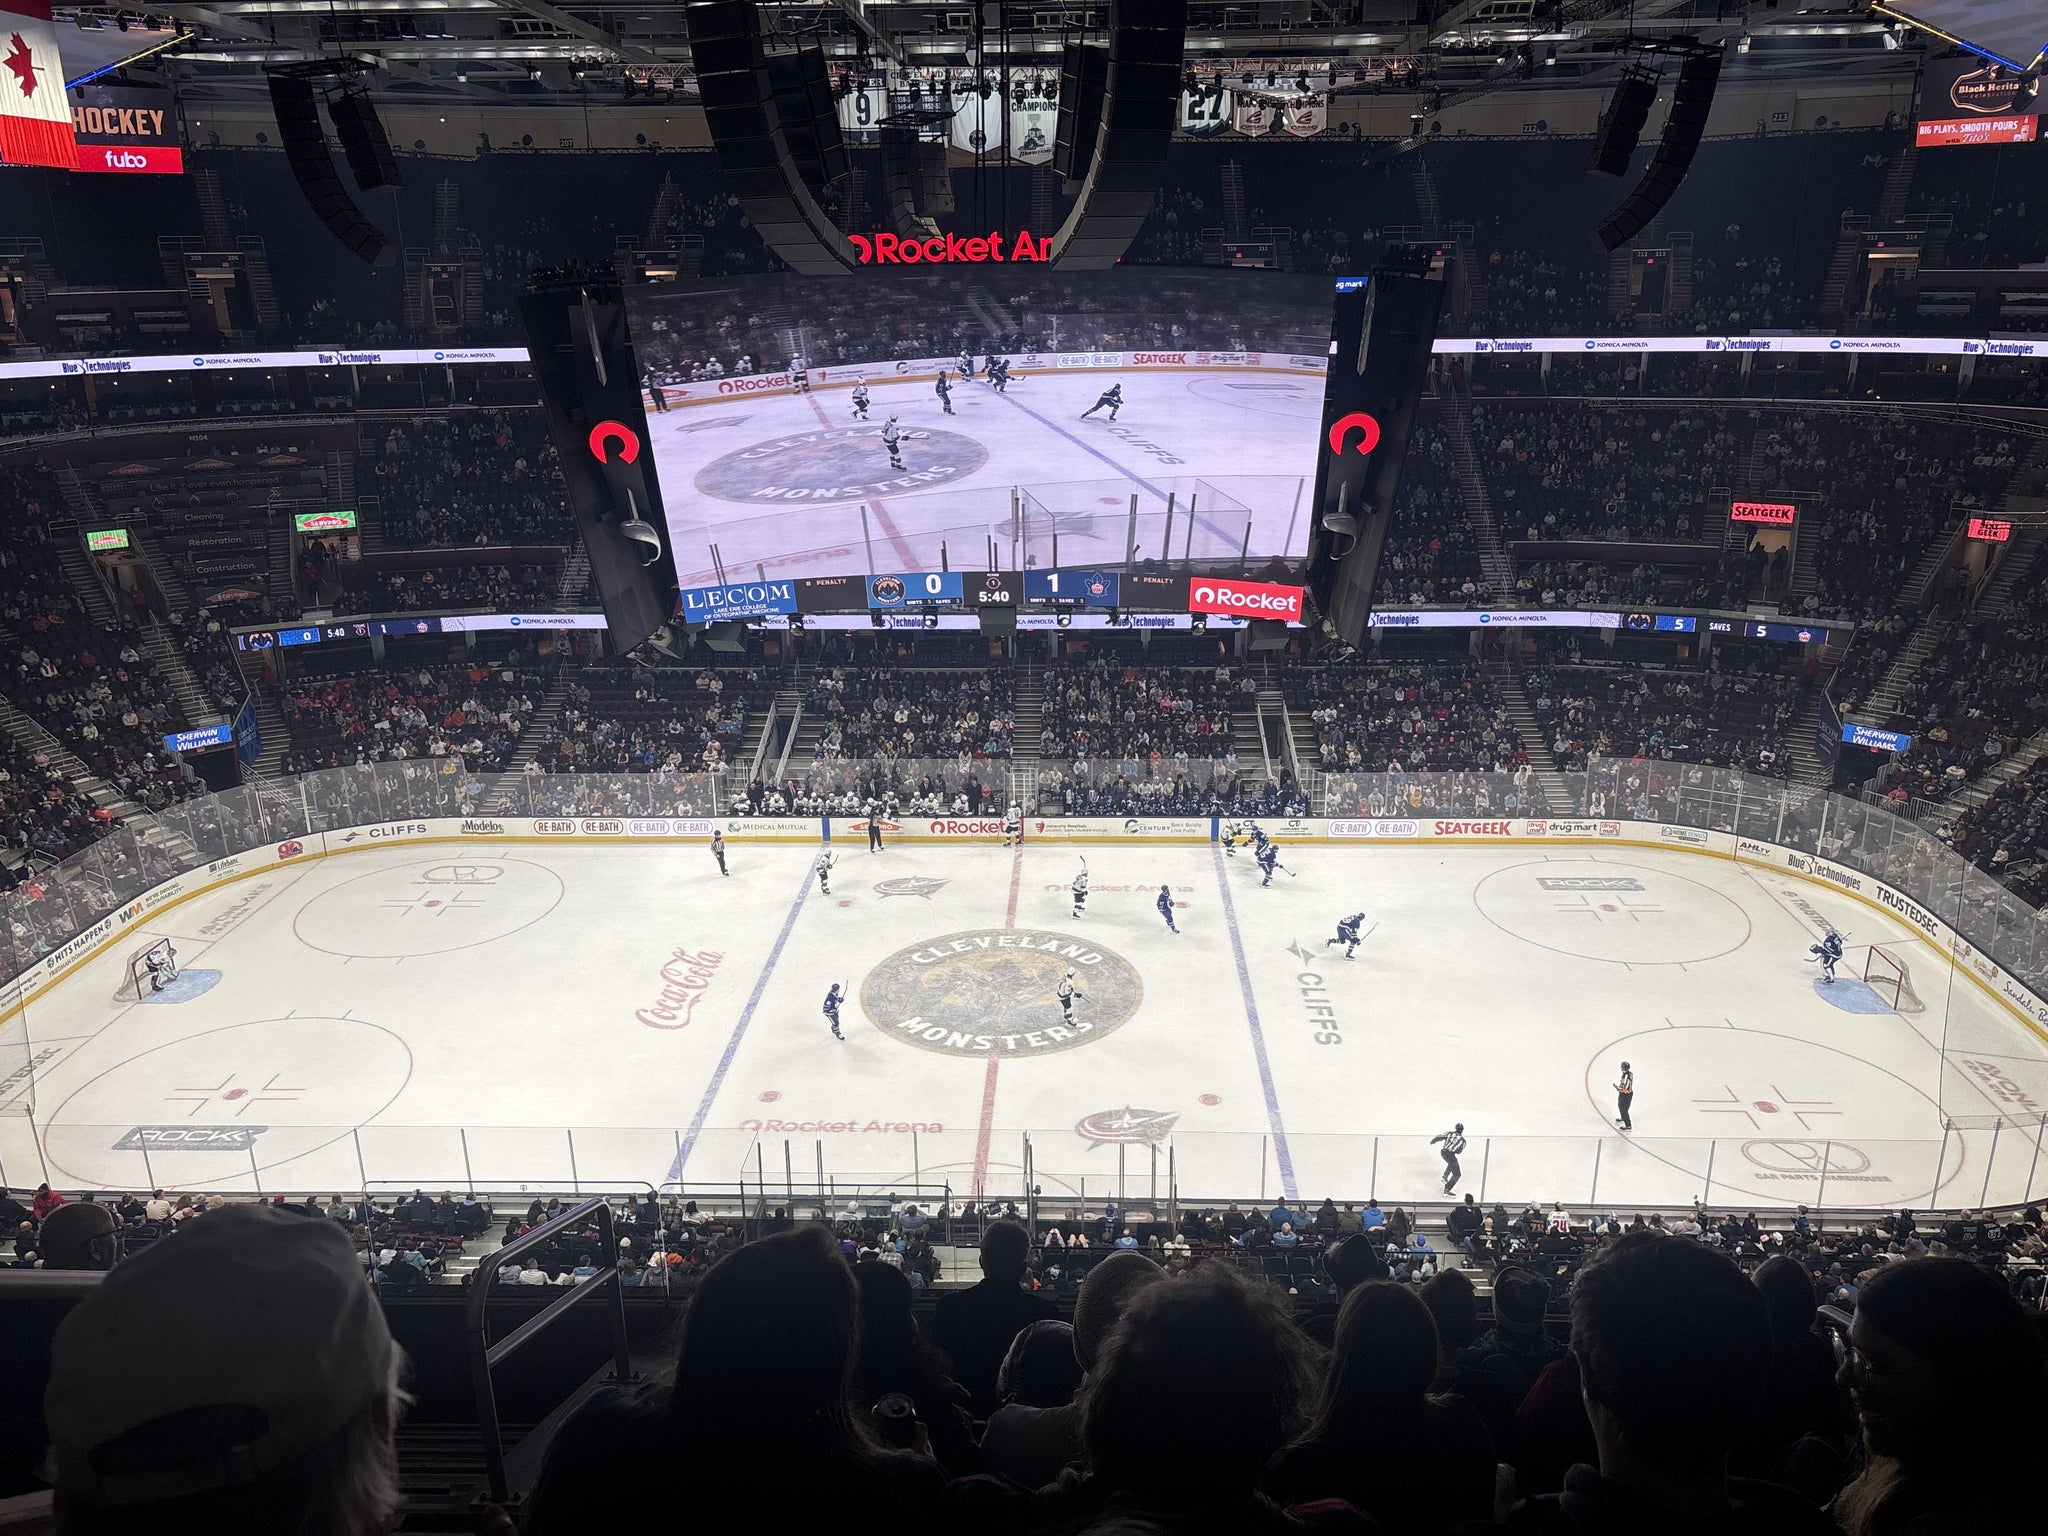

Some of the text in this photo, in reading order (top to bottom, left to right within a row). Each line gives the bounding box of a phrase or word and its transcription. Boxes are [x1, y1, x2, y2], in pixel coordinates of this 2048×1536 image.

[1958, 84, 1986, 94] Black
[856, 94, 871, 126] 9
[1011, 101, 1058, 113] CHAMPIONS
[70, 106, 165, 136] HOCKEY
[1919, 120, 2018, 135] BIG PLAYS. SMOOTH POURS
[105, 151, 147, 168] fubo
[875, 230, 1054, 264] Rocket Ar
[1345, 280, 1363, 288] mart
[1475, 340, 1533, 352] Blue Technologies
[1706, 339, 1771, 351] Blue Technologies
[1963, 341, 2034, 356] Blue Technologies
[318, 352, 381, 364] Blue Technologies
[1133, 353, 1186, 365] SEATGEEK
[62, 360, 131, 373] Blue Technologies
[735, 373, 792, 392] Rocket
[1107, 427, 1186, 466] CLIFFS
[752, 465, 957, 499] MONSTERS
[1734, 506, 1791, 520] SEATGEEK
[1977, 528, 1999, 538] GEEK
[188, 535, 244, 547] Restoration.
[196, 562, 257, 574] Construction.
[816, 578, 847, 586] PENALTY
[925, 574, 942, 594] 0
[1047, 573, 1059, 593] 1
[686, 584, 791, 611] LECOM
[979, 591, 1010, 603] 5:40
[1217, 587, 1297, 613] Rocket
[752, 607, 780, 615] MEDICINE
[548, 617, 575, 625] MINOLTA
[893, 616, 925, 628] Technolog
[1133, 615, 1175, 629] Technologies
[1376, 614, 1420, 627] Technologies
[1674, 618, 1767, 637] 5 SAVES 5
[303, 631, 311, 640] 0
[327, 628, 345, 638] 5:40
[381, 624, 387, 634] 1
[176, 728, 218, 743] SHERWIN
[1855, 726, 1898, 742] SHERWIN
[369, 823, 427, 838] CLIFFS
[463, 819, 499, 832] Modelo
[743, 823, 807, 831] MEDICAL MUTUAL
[947, 820, 1004, 834] Rocket
[1434, 821, 1512, 836] SEATGEEK
[1549, 823, 1597, 833] drug mart
[1601, 822, 1617, 830] drug
[1788, 854, 1861, 891] Blue Technologies
[159, 882, 180, 895] DRIVING
[1064, 884, 1132, 892] Rcket
[118, 901, 145, 924] WM
[1876, 885, 1939, 938] TRUSTEDSEC
[54, 923, 104, 963] HITS HAPPEN
[911, 934, 1103, 966] CLEVELAND
[635, 947, 726, 1030] Coca-Cola
[1297, 972, 1343, 1046] CLIFFS
[898, 1016, 1094, 1050] MONSTERS
[763, 1119, 943, 1133] Rocket Arena
[1755, 1173, 1779, 1181] CAR
[1782, 1174, 1818, 1182] PARTS
